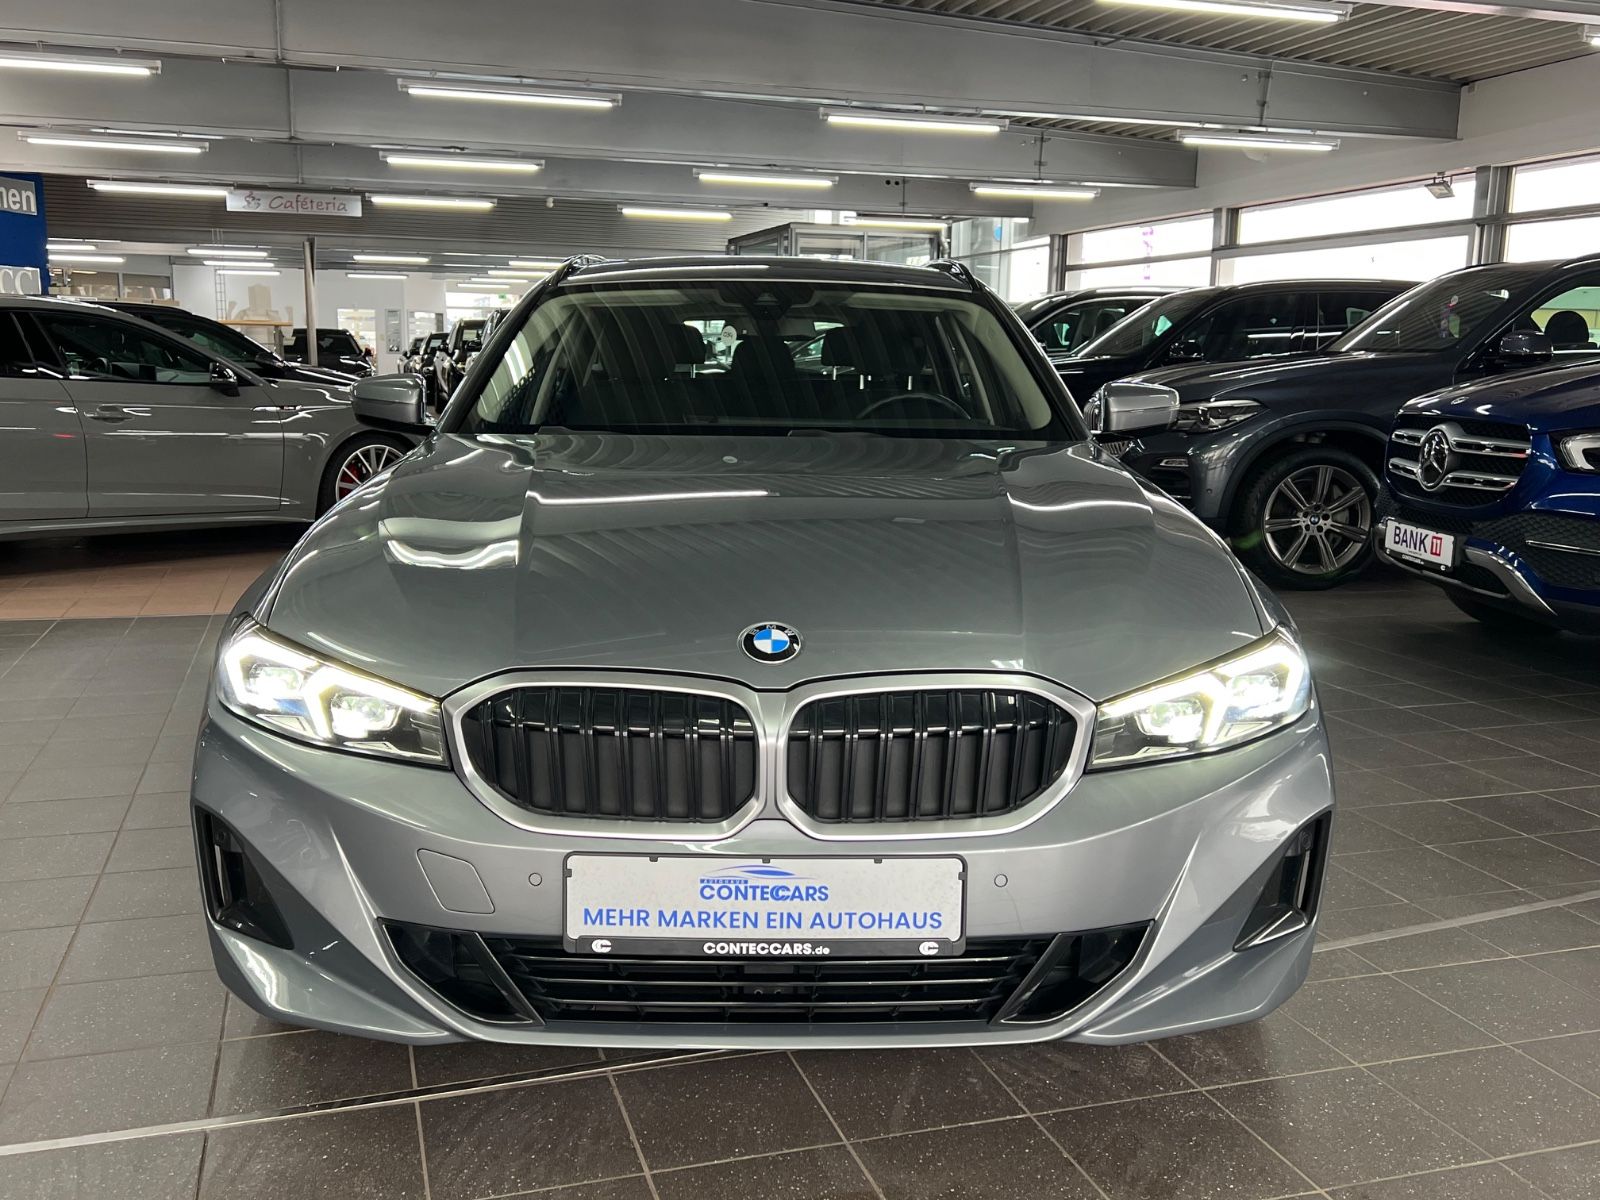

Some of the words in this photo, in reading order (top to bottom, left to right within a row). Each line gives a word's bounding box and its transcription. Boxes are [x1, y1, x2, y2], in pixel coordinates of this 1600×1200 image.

[268, 194, 348, 213] Caféteria
[1393, 526, 1429, 553] BANK
[700, 885, 829, 901] CONTECCARS
[584, 908, 650, 927] MEHR
[658, 909, 759, 928] MARKEN
[766, 911, 802, 929] EIN
[811, 911, 943, 930] AUTOHAUS
[703, 942, 830, 955] CONTECCARS.de
